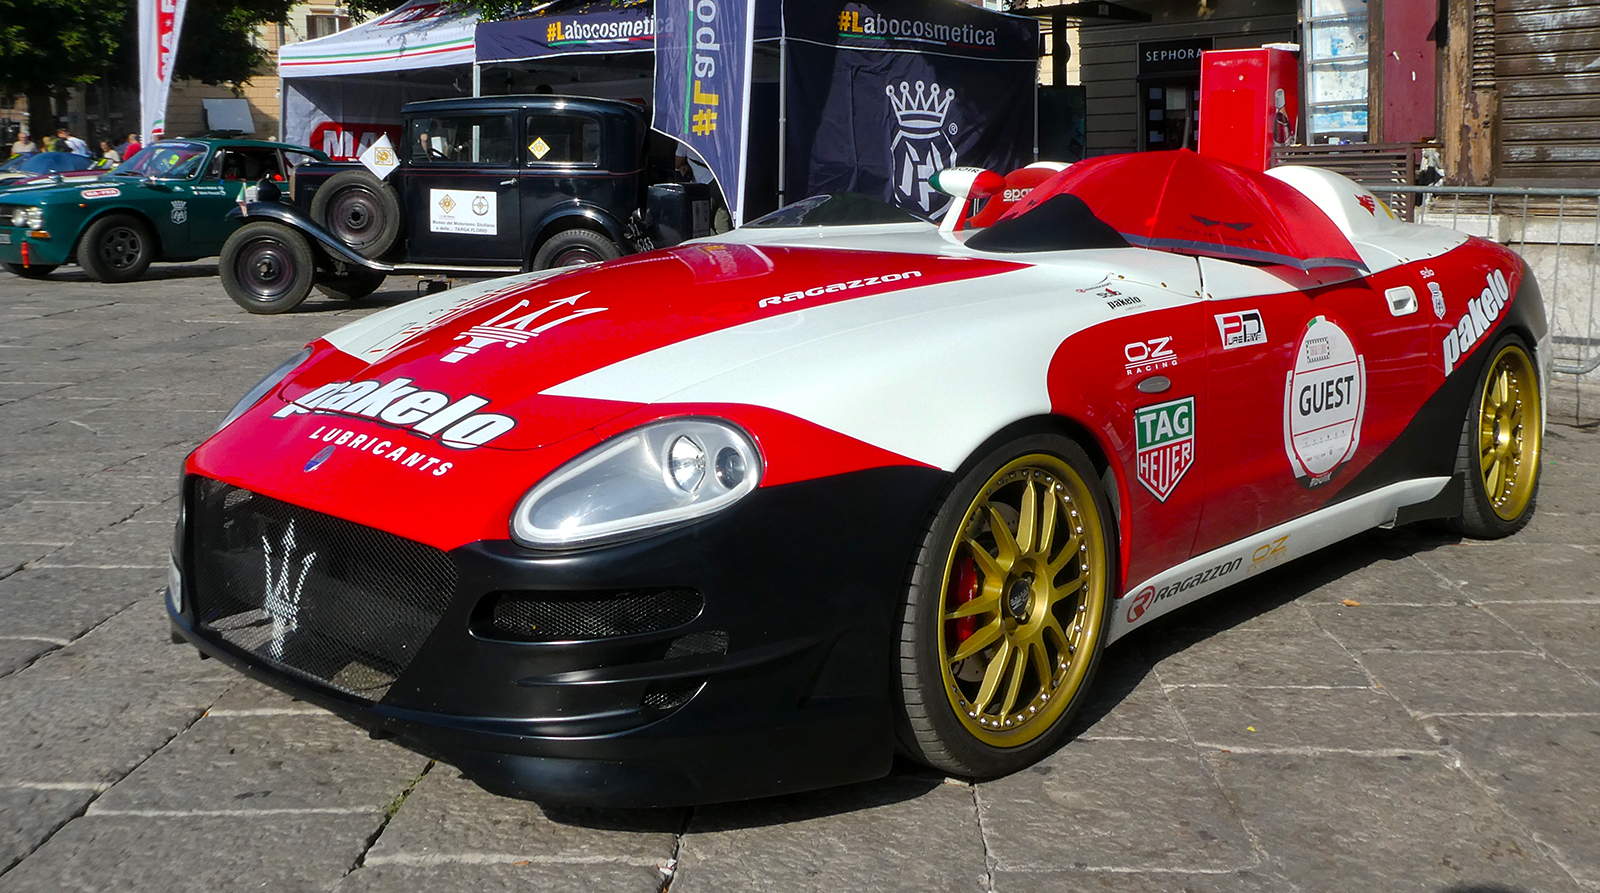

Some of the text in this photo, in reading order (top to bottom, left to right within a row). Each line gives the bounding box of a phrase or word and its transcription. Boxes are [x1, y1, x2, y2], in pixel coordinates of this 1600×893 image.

[837, 10, 996, 46] #Labocosmetica
[1145, 48, 1202, 62] SEPHORA
[1107, 295, 1142, 310] pakelo
[1441, 268, 1510, 378] pakelo
[1126, 360, 1178, 376] RACING
[271, 376, 517, 450] pakelo
[1299, 375, 1354, 417] GUEST
[1139, 405, 1190, 444] TAG
[308, 425, 454, 478] LUBRICANTS
[1139, 442, 1192, 494] HEUER
